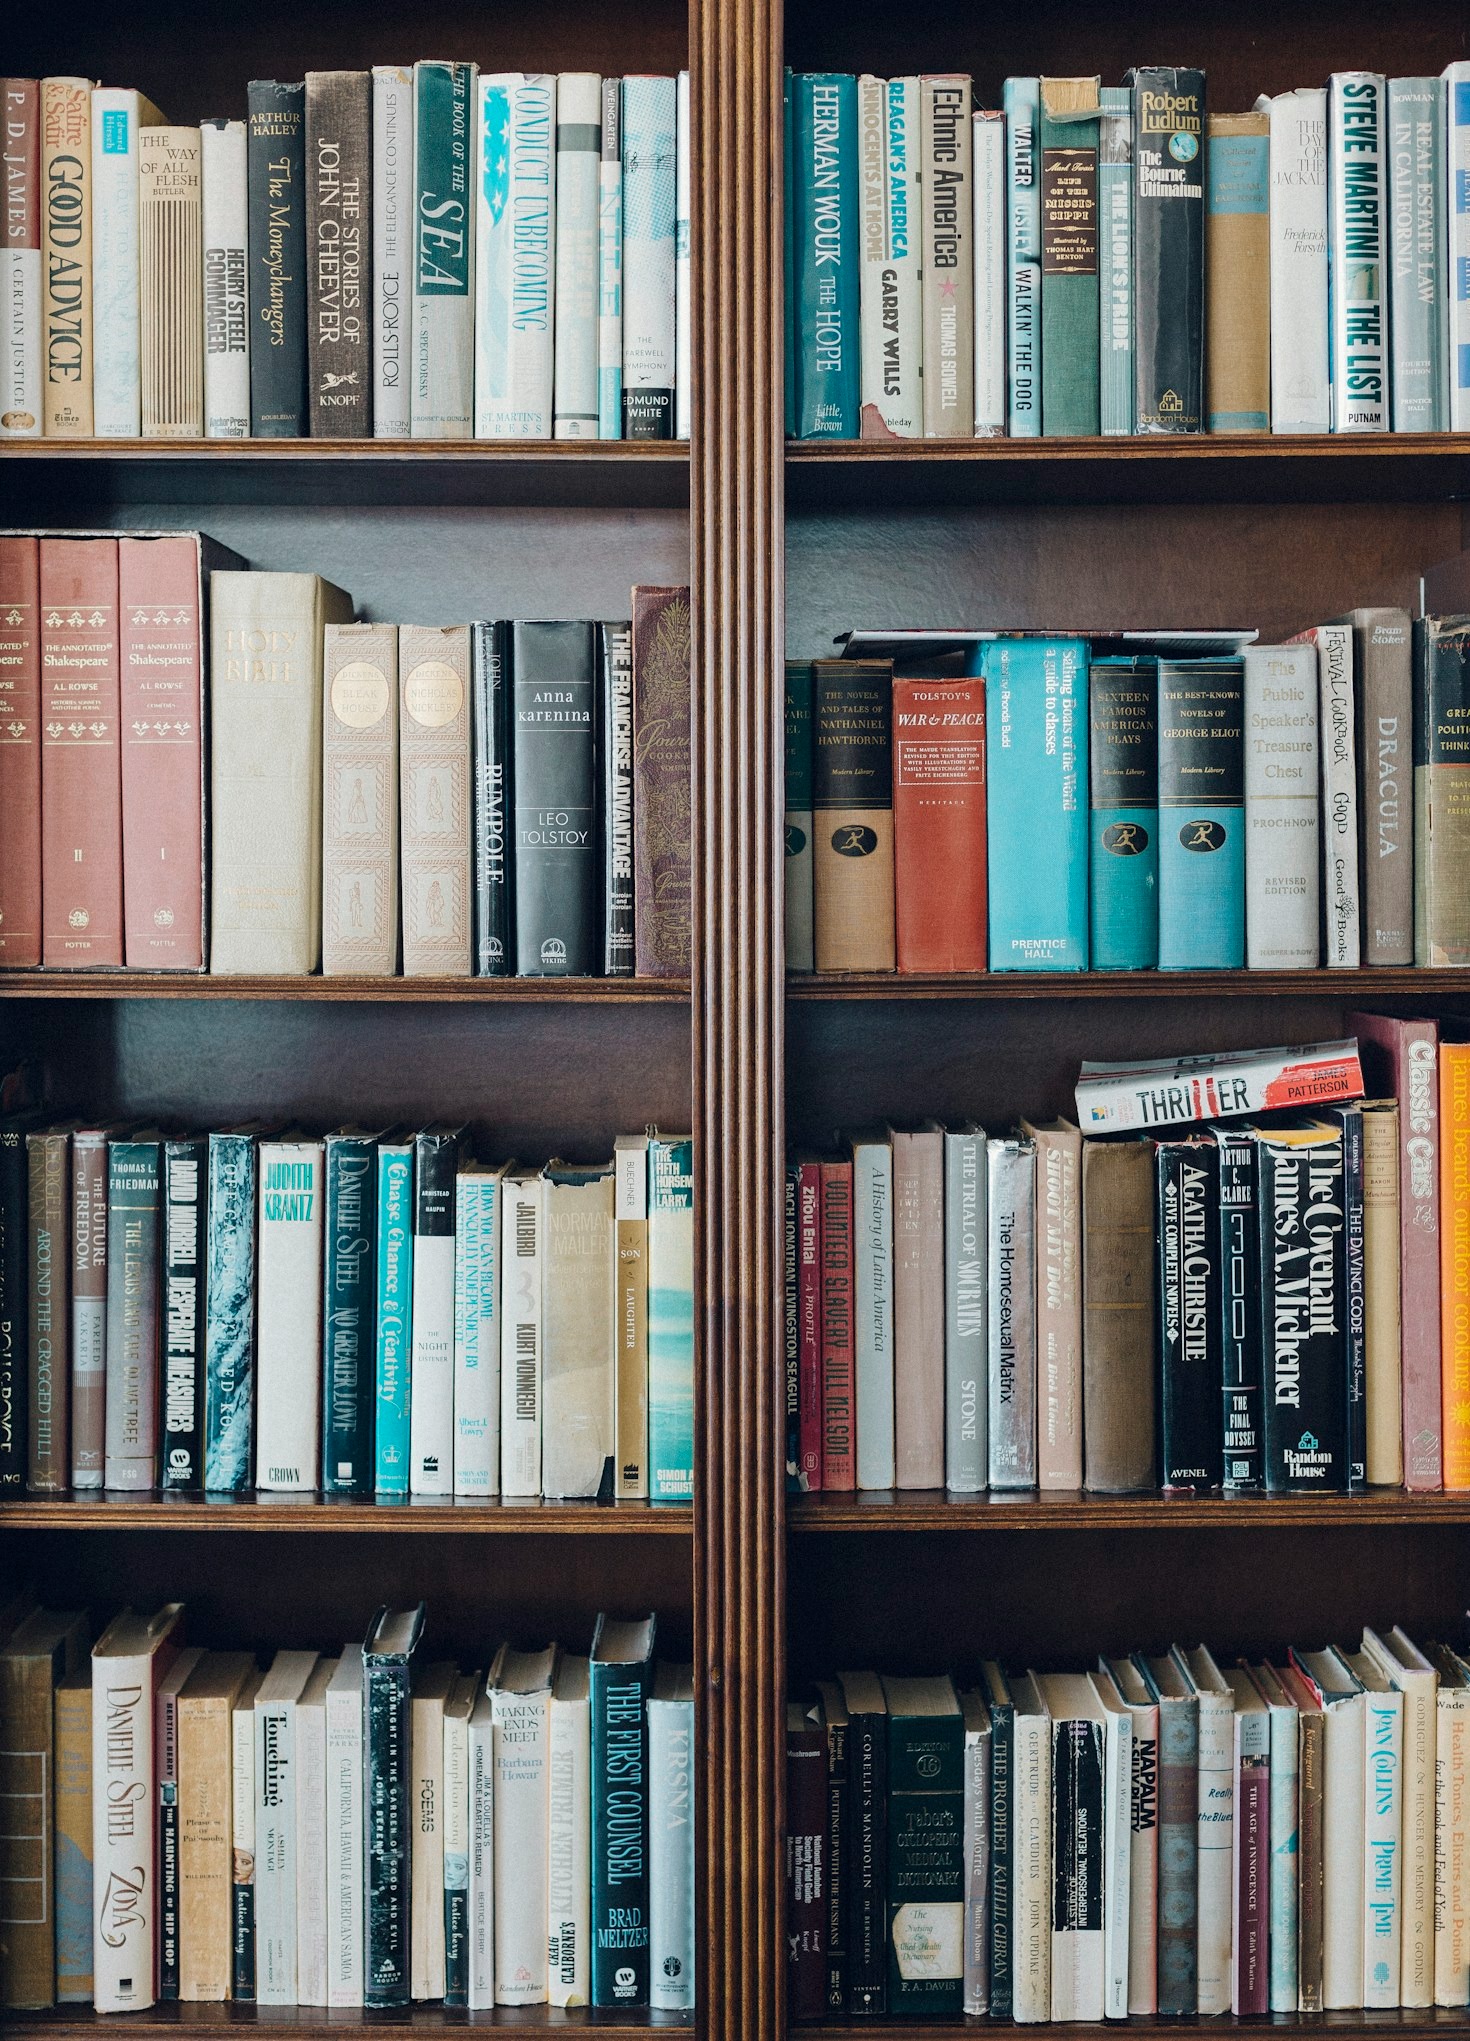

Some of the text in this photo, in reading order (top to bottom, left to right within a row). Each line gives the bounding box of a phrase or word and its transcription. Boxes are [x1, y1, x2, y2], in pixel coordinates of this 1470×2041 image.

[1141, 91, 1198, 112] Robert
[251, 111, 301, 123] ARTHUR
[607, 88, 616, 149] WEINGARTEN
[1141, 111, 1201, 134] Ludlum
[253, 126, 298, 136] HAILEY
[513, 88, 550, 184] CONDUCT
[141, 136, 169, 148] THE
[167, 148, 198, 159] WAY
[1140, 151, 1162, 166] The
[141, 162, 189, 173] OF ALL
[813, 85, 840, 266] HERMAN WOUK
[1140, 166, 1186, 183] Bourne
[1343, 83, 1379, 259] STEVE MARTINI
[156, 175, 198, 186] FLESH
[933, 89, 963, 268] Ethnic America
[152, 188, 185, 196] BUTLER
[1140, 182, 1202, 198] Ultimatum
[261, 156, 291, 345] The Moneychangers
[318, 138, 340, 344] JOHN CHEEVER
[420, 191, 464, 289] SEA
[48, 155, 84, 383] GOOD ADVICE
[512, 195, 549, 331] UNBECOMING
[206, 250, 226, 354] COMMAGER
[227, 248, 245, 352] HENRY STEELE
[383, 271, 399, 388] ROLLS-ROYCE
[816, 276, 841, 372] THE HOPE
[940, 305, 957, 409] THOMAS SOWELL
[1346, 305, 1381, 404] THE LIST
[319, 395, 359, 406] KNOPF
[1348, 412, 1381, 423] PUTNAM
[44, 655, 109, 668] Shakespeare
[129, 654, 192, 666] Shakespeare
[69, 683, 98, 691] ROWSE
[913, 692, 970, 701] TOLSTOY'S
[820, 719, 885, 729] NATHANIEL
[899, 714, 984, 726] WAR & PEACE
[1180, 710, 1212, 718] NOVELS
[818, 736, 887, 745] HAWTHORNE
[1163, 728, 1241, 738] GEORGE ELIOT
[611, 630, 631, 879] THE FRANCHISE ADVANTAGE
[1378, 717, 1399, 858] DRACULA
[485, 763, 504, 884] RUMPOLE
[539, 813, 568, 826] LEO
[1253, 819, 1315, 828] PROCHNOW
[521, 831, 588, 844] TOLSTOY
[1265, 877, 1306, 885] REVISED
[1265, 886, 1306, 894] EDITION
[1012, 940, 1066, 949] PRENTICE
[1024, 949, 1053, 958] HALL
[1221, 1149, 1251, 1164] ARTHUR
[112, 1163, 156, 1173] THOMAS L.
[264, 1162, 313, 1190] JUDITH
[110, 1178, 159, 1190] FRIEDMAN
[1223, 1186, 1252, 1201] CLARKE
[168, 1160, 198, 1267] DAVID MORRELL
[264, 1194, 313, 1221] KRANTZ
[516, 1201, 536, 1257] JAILBIRD
[1303, 1143, 1344, 1336] The Covenant
[957, 1144, 981, 1338] THE TRIAL OF SOCRATES
[1183, 1163, 1211, 1361] AGATHA CHRISTIE
[1267, 1145, 1309, 1408] James A. Michener
[999, 1212, 1015, 1403] The Homosexual Matrix
[626, 1288, 634, 1349] LAUGHTER
[167, 1277, 196, 1432] DESPERATE MEASURES
[517, 1324, 536, 1421] KURT VONNEGUT
[961, 1380, 975, 1441] STONE
[1233, 1396, 1248, 1410] THE
[1230, 1414, 1250, 1427] FINAL
[1224, 1431, 1255, 1446] ODYSSEY
[1284, 1449, 1331, 1465] Random
[268, 1468, 300, 1482] CROWN
[1170, 1468, 1207, 1478] AVENEL
[1289, 1463, 1326, 1478] House
[495, 1705, 544, 1718] MAKING
[504, 1719, 539, 1730] ENDS
[502, 1731, 539, 1743] MEET
[106, 1685, 145, 1846] DANIELLE STEEL
[607, 1682, 642, 1885] THE FIRST COUNSEL
[1141, 1740, 1156, 1830] NAPALM
[421, 1779, 433, 1832] POEMS
[1030, 1731, 1039, 1879] GERTRUDE CLAUDIUS
[1249, 1786, 1257, 1807] THE
[863, 1734, 872, 1889] CORELLI'S MANDOLIN
[1249, 1814, 1257, 1833] AGE
[165, 1828, 175, 1892] HAUNTING
[1249, 1845, 1257, 1910] INNOCENCE
[1369, 1825, 1396, 1938] PRIME TIME
[100, 1865, 146, 1948] ZOYA
[167, 1898, 173, 1908] OF
[166, 1912, 174, 1936] HIP
[609, 1907, 641, 1927] BRAD
[598, 1929, 647, 1948] MELTZER
[1029, 1900, 1039, 1975] JOHN UPDIKE
[166, 1939, 174, 1966] HOP
